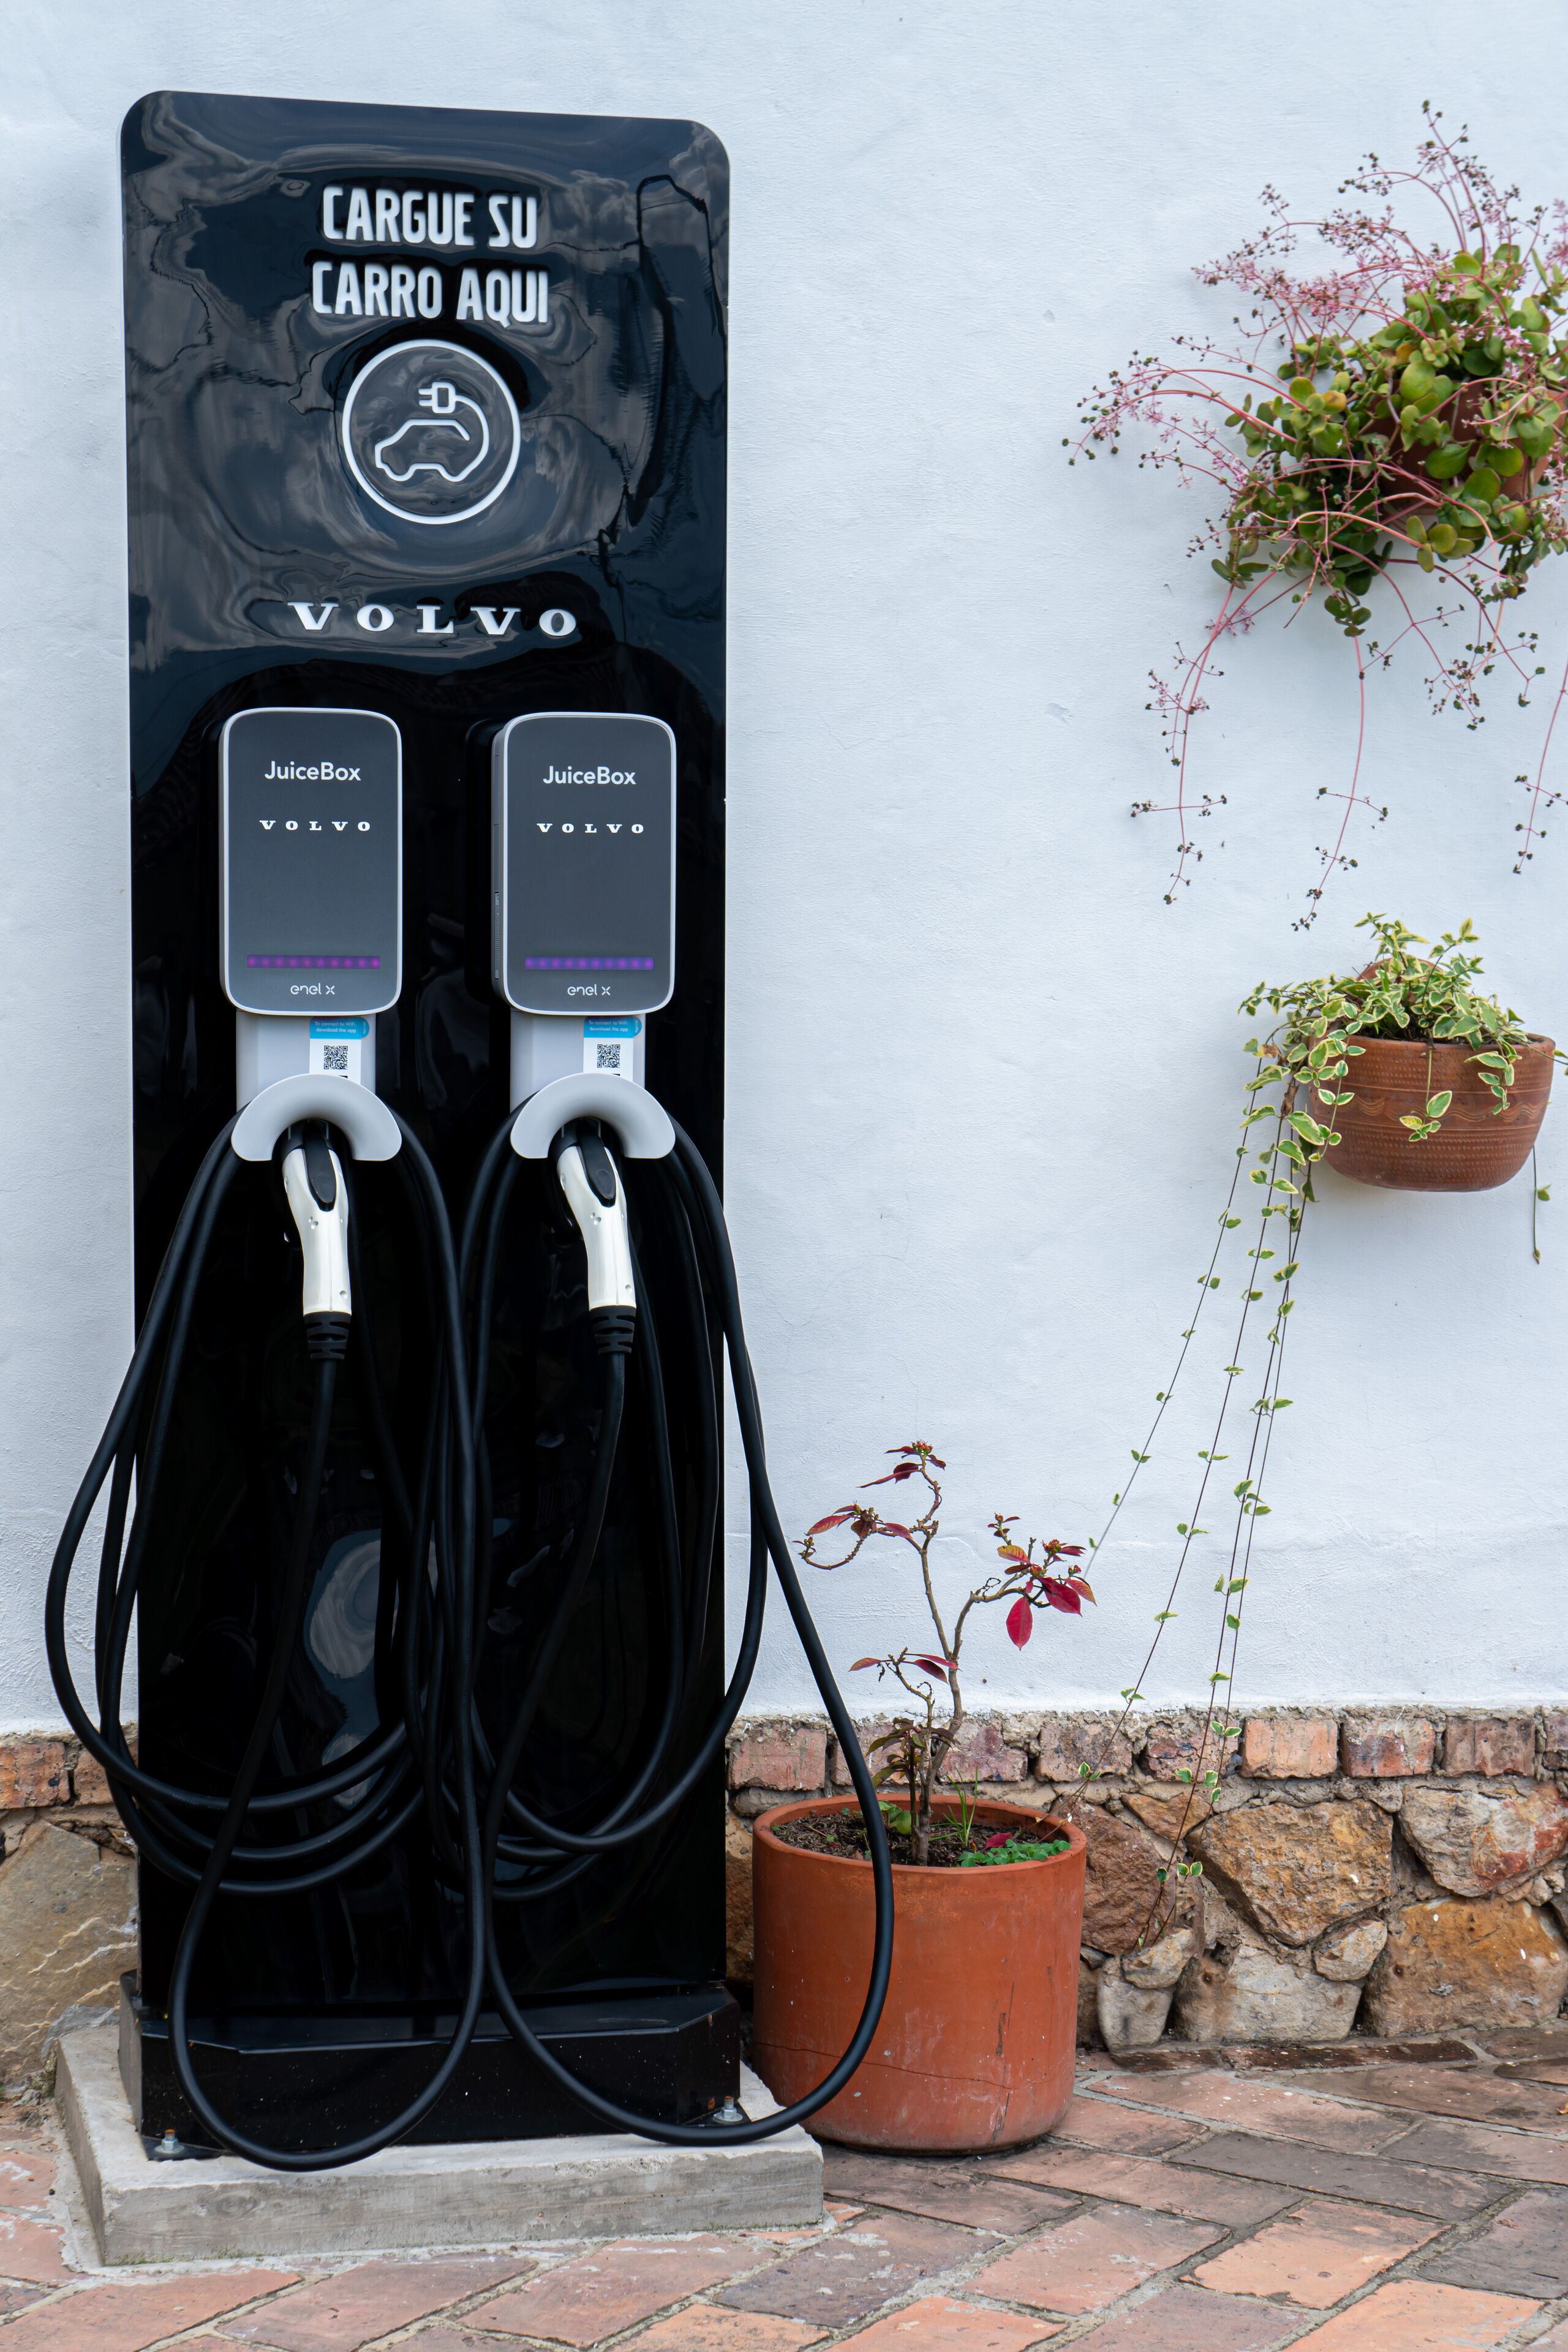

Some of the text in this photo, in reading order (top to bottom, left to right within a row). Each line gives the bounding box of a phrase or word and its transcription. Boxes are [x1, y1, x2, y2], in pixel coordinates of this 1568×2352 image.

[323, 186, 537, 249] CARGUE SU
[312, 262, 549, 328] CARRO AQUI
[287, 601, 576, 637] VOLVO
[264, 761, 361, 781] JuiceBox
[543, 765, 636, 785] JuiceBox
[259, 820, 371, 832] VOLVO
[537, 823, 644, 834] VOLVO
[290, 982, 322, 996] enel
[567, 984, 598, 997] enel
